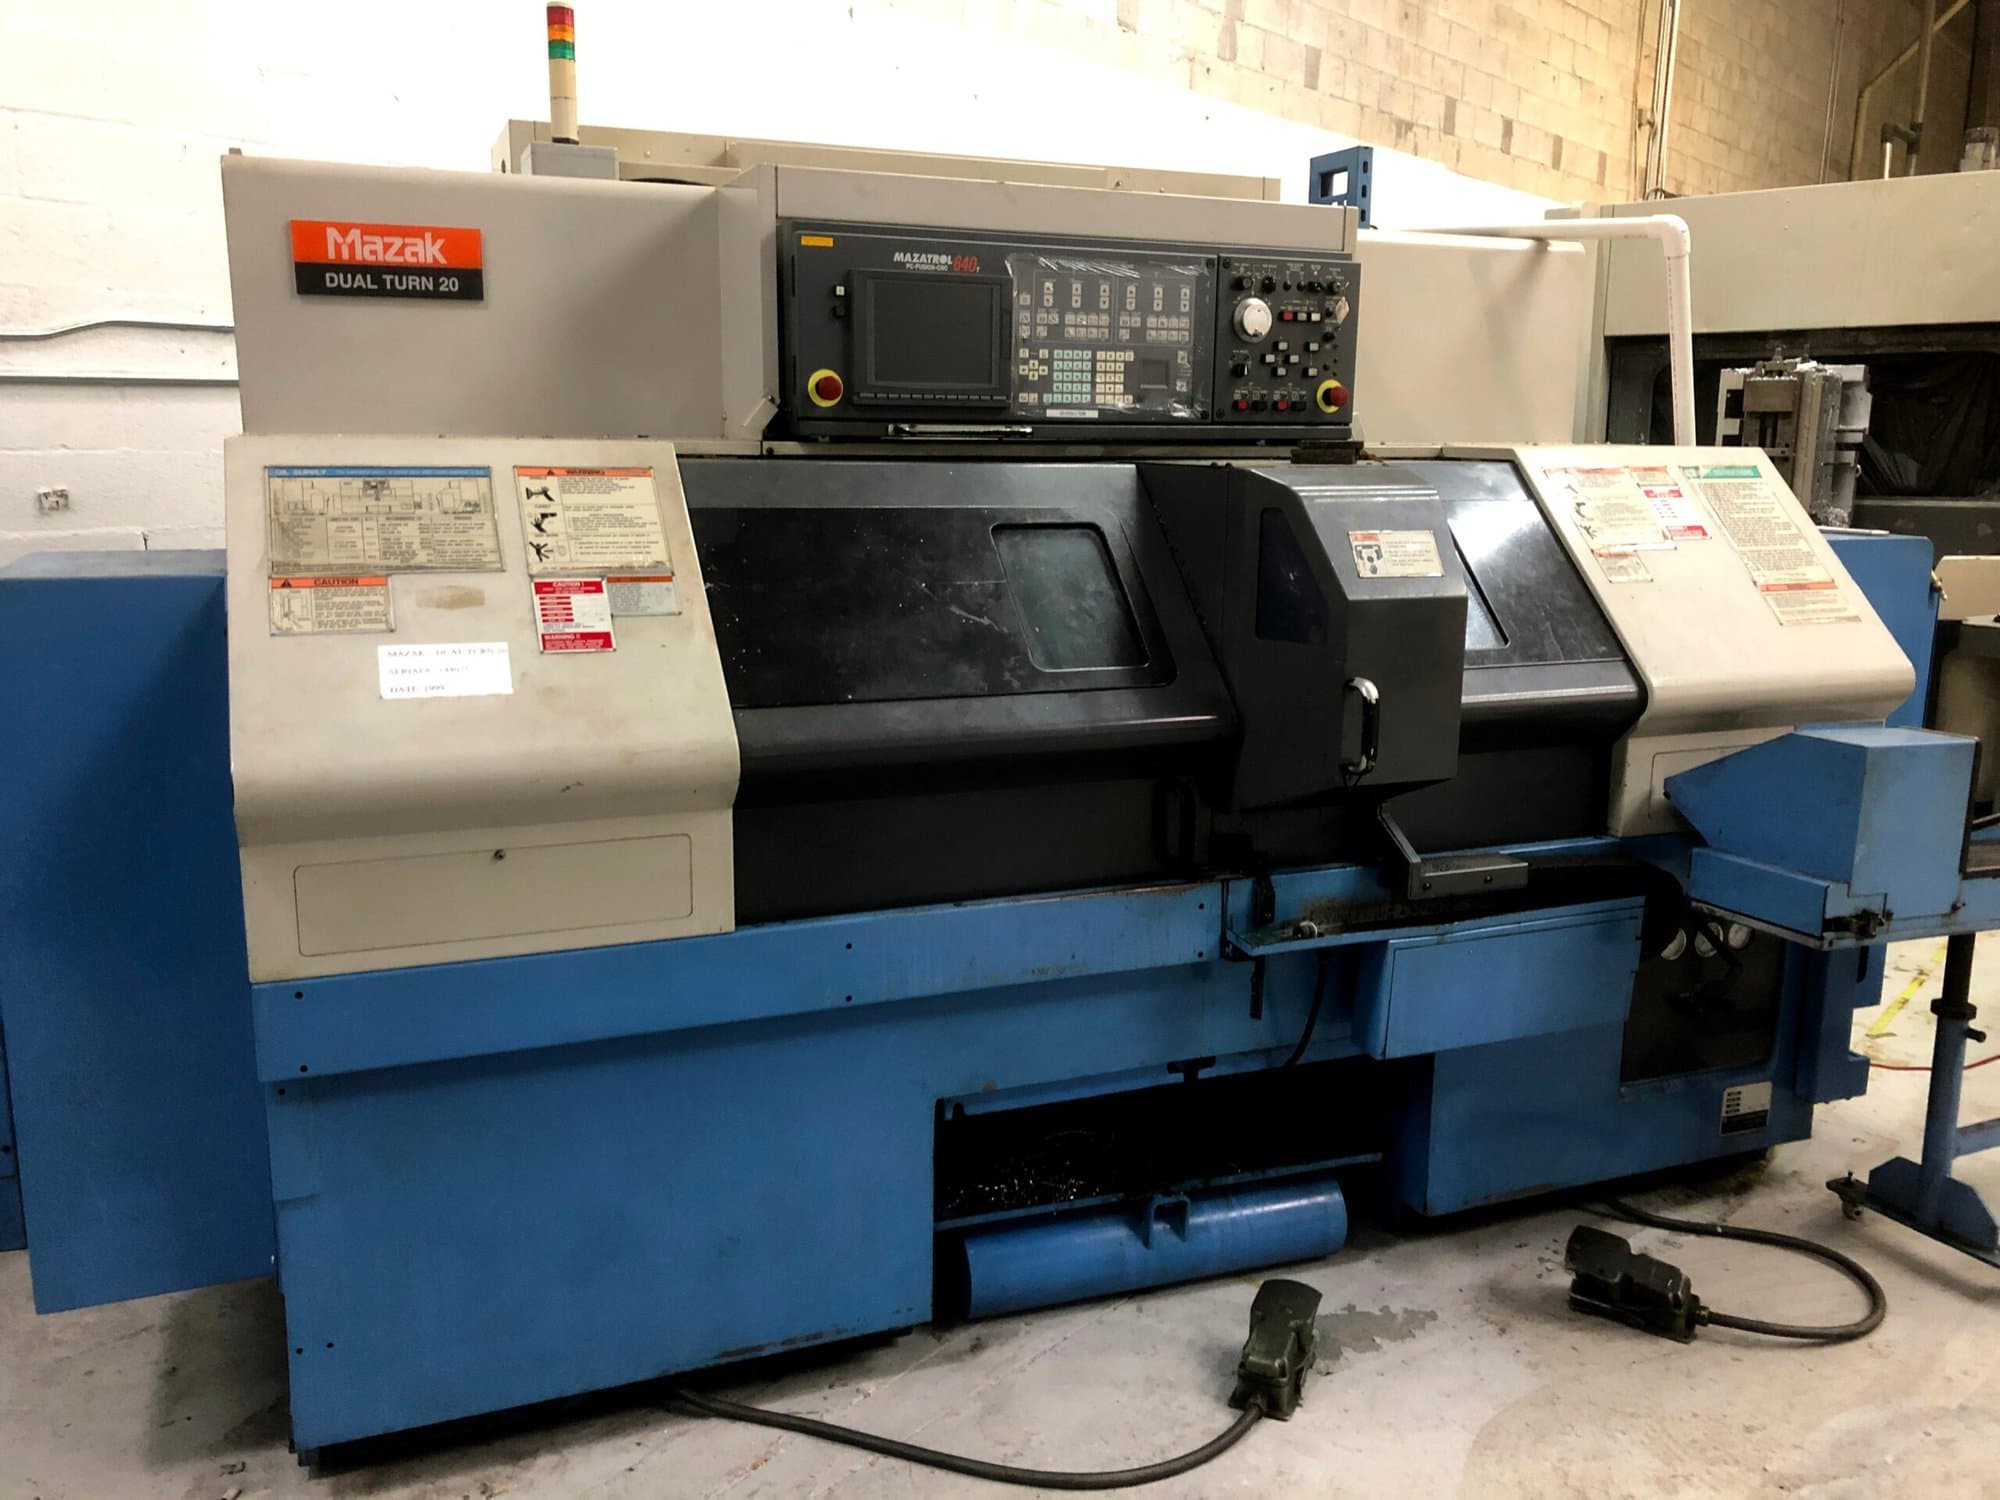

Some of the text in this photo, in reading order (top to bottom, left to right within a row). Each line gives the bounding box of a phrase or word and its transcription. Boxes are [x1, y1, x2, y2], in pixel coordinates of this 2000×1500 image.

[325, 226, 447, 265] Mazak
[893, 252, 953, 265] MAZATROL
[325, 272, 459, 292] DUAL TURN 20
[314, 577, 359, 586] CAUTION
